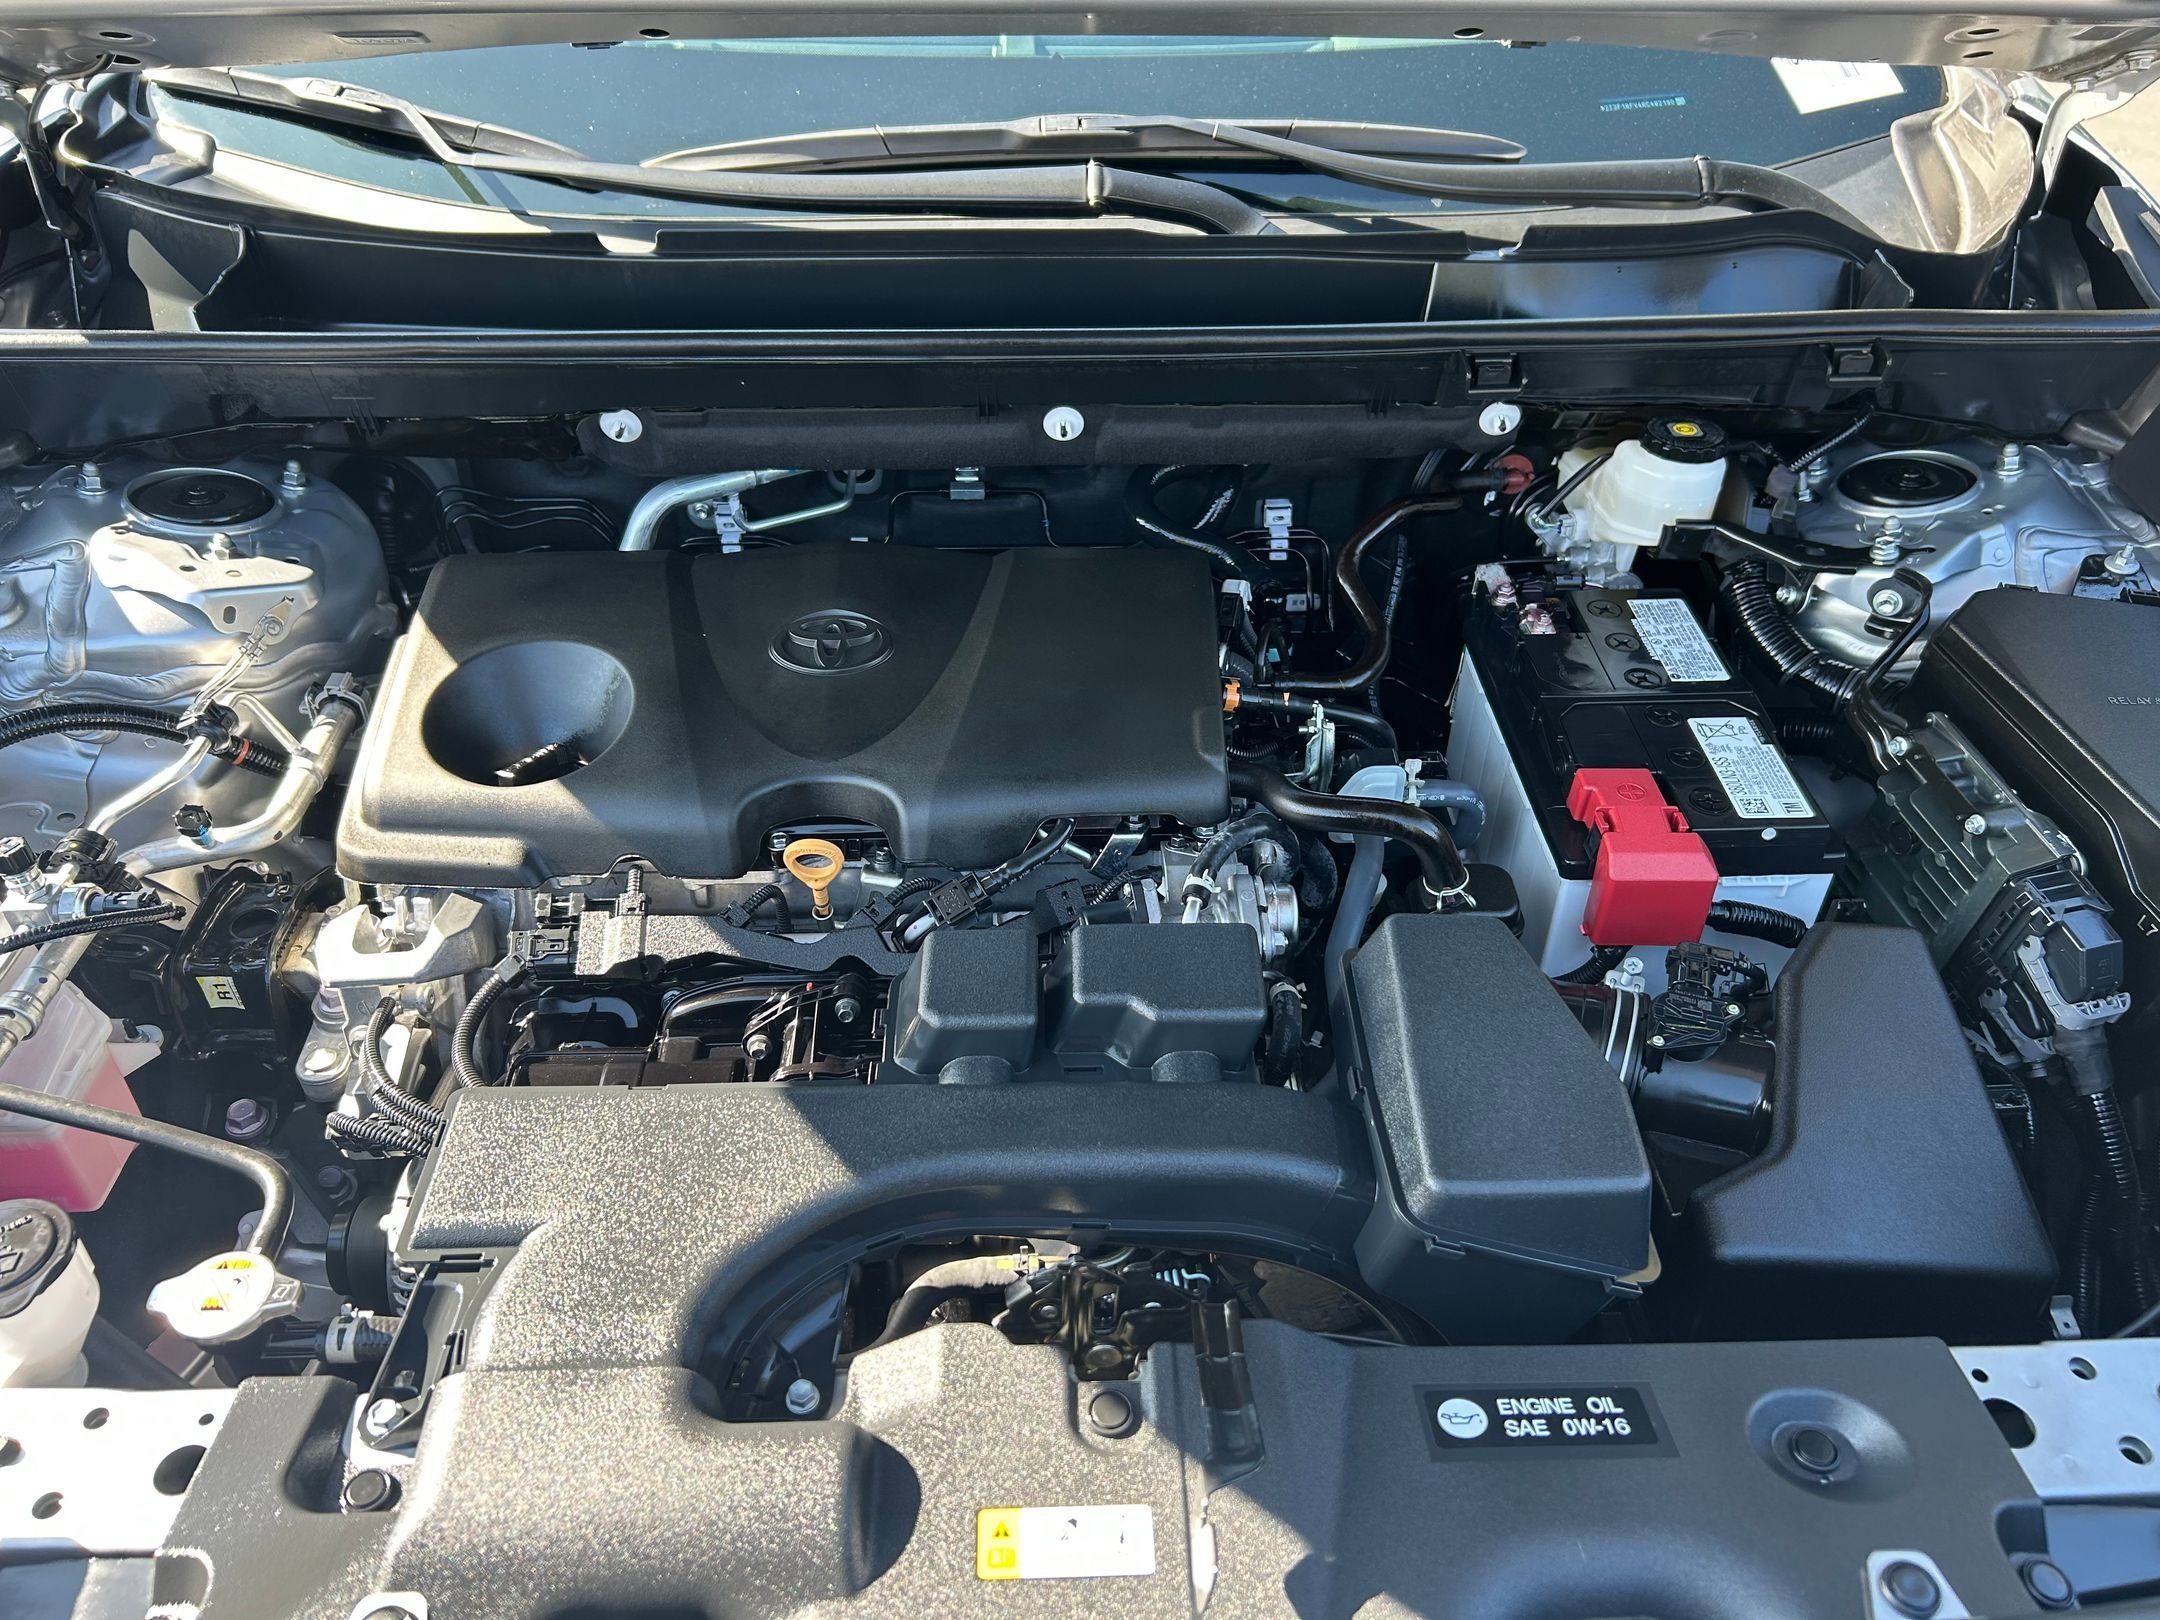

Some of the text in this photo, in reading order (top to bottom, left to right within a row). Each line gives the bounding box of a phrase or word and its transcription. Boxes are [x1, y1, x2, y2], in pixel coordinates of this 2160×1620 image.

[2107, 696, 2151, 705] RELAY
[1782, 801, 1804, 814] TM
[212, 984, 233, 999] R1
[1496, 1396, 1625, 1415] ENGINE OIL
[1504, 1417, 1632, 1437] SAE 0W-16
